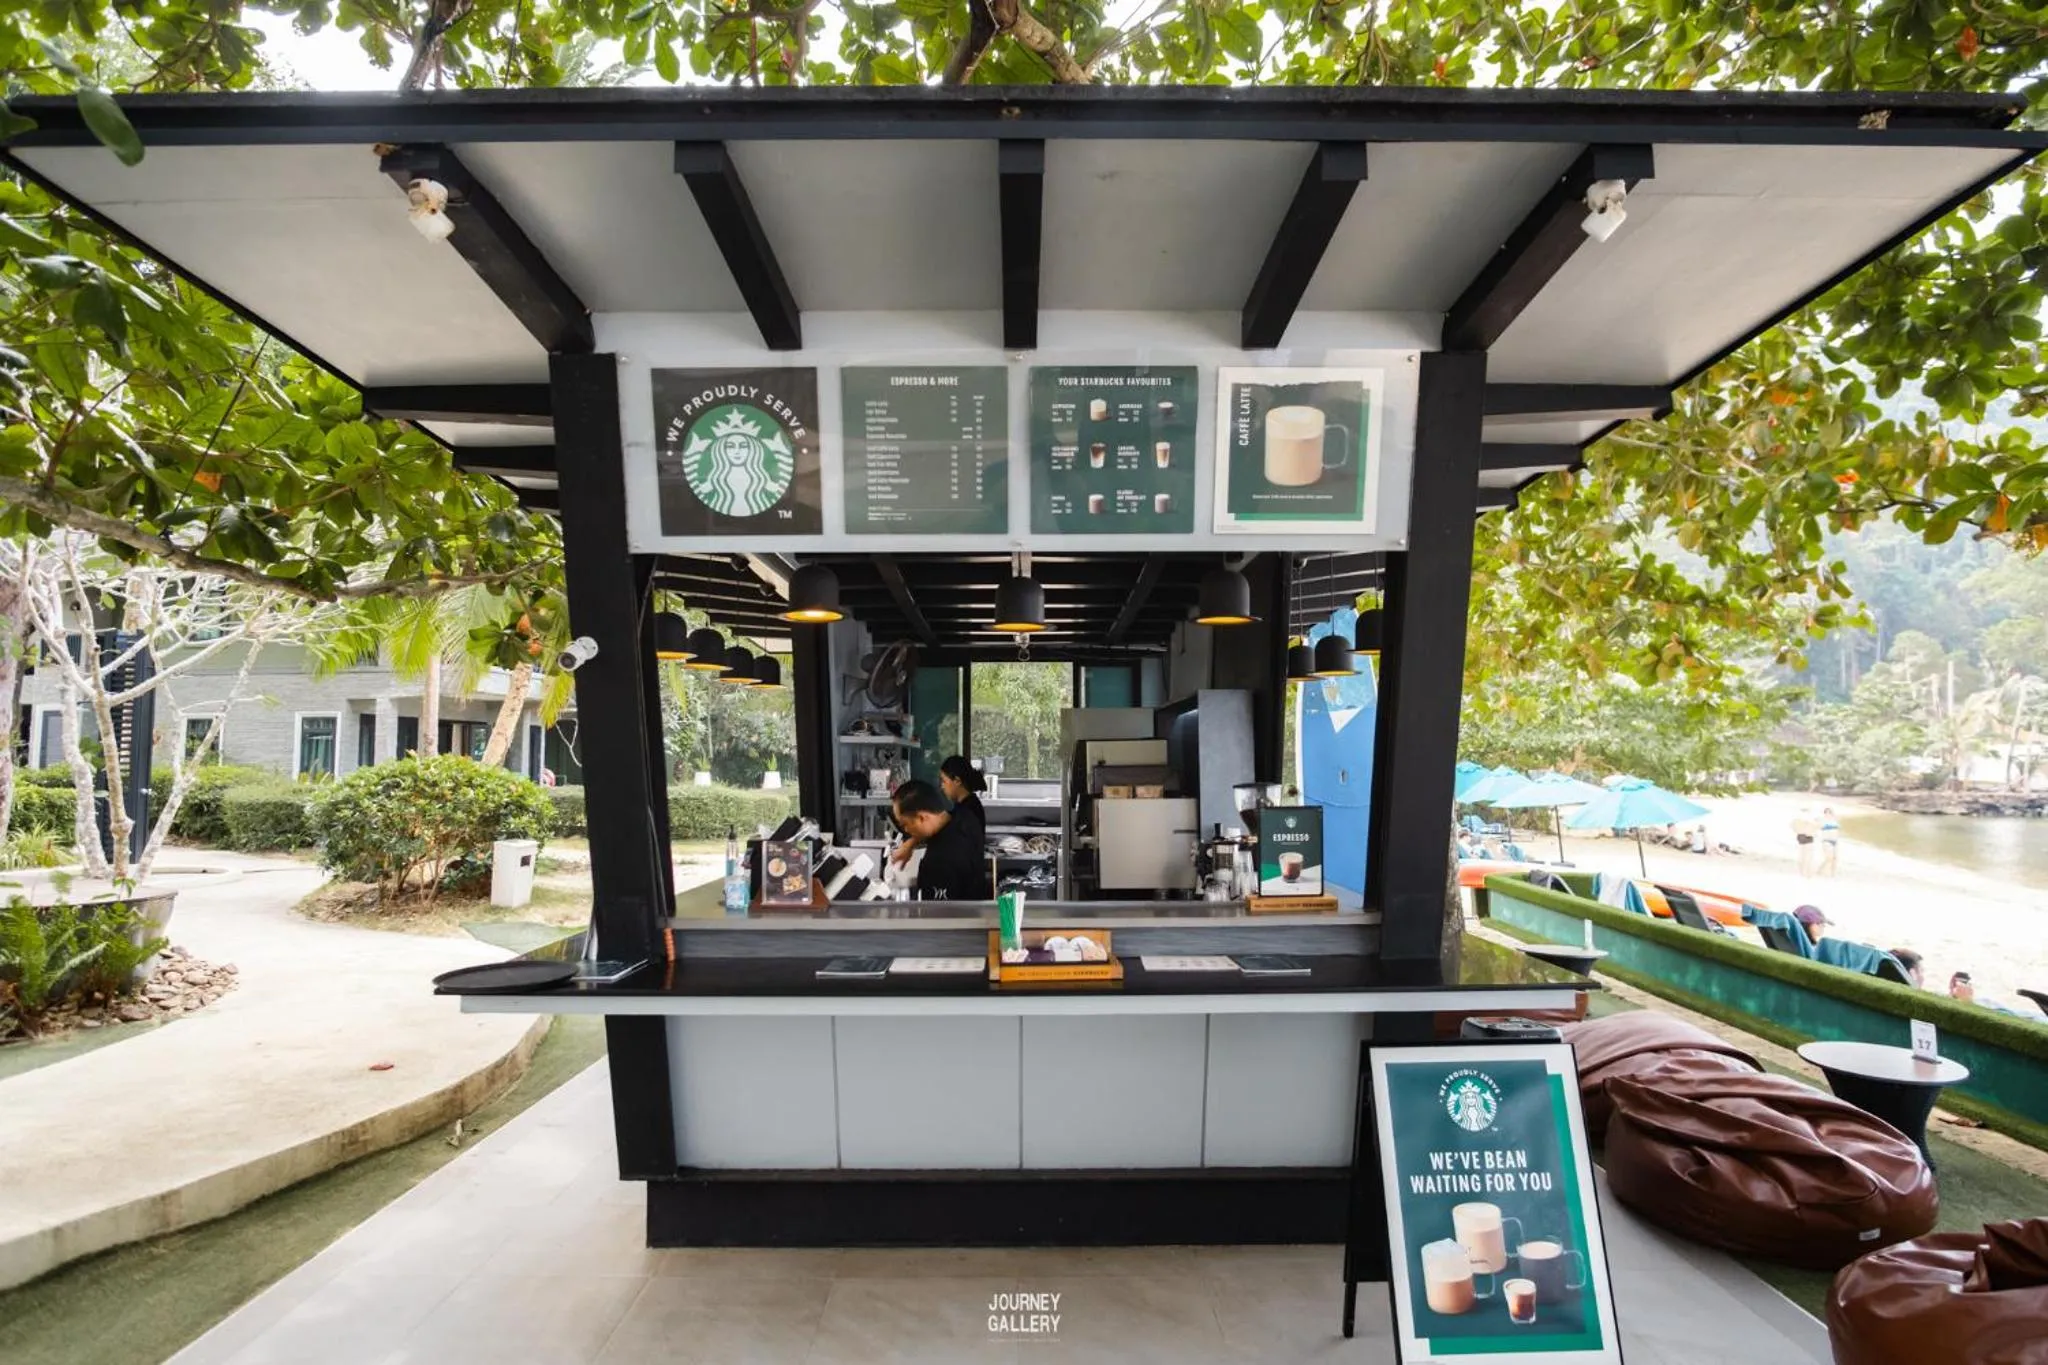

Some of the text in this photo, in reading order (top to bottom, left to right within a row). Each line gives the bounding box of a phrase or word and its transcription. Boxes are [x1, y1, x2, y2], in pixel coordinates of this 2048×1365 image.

[890, 376, 928, 386] ESPRESSO
[937, 376, 959, 386] MORE
[1058, 377, 1172, 386] YOUR STARBUCKS FAVOURITES
[1240, 386, 1252, 415] LATTE
[666, 385, 806, 442] WE PROUDLY SERVE
[778, 510, 793, 519] TM
[1272, 833, 1310, 842] ESPRESSO
[1917, 1038, 1932, 1050] 17
[1446, 1069, 1479, 1085] PROUDLY
[1429, 1149, 1528, 1171] WE'VE BEAN
[1410, 1171, 1552, 1194] WAITING FOR YOU
